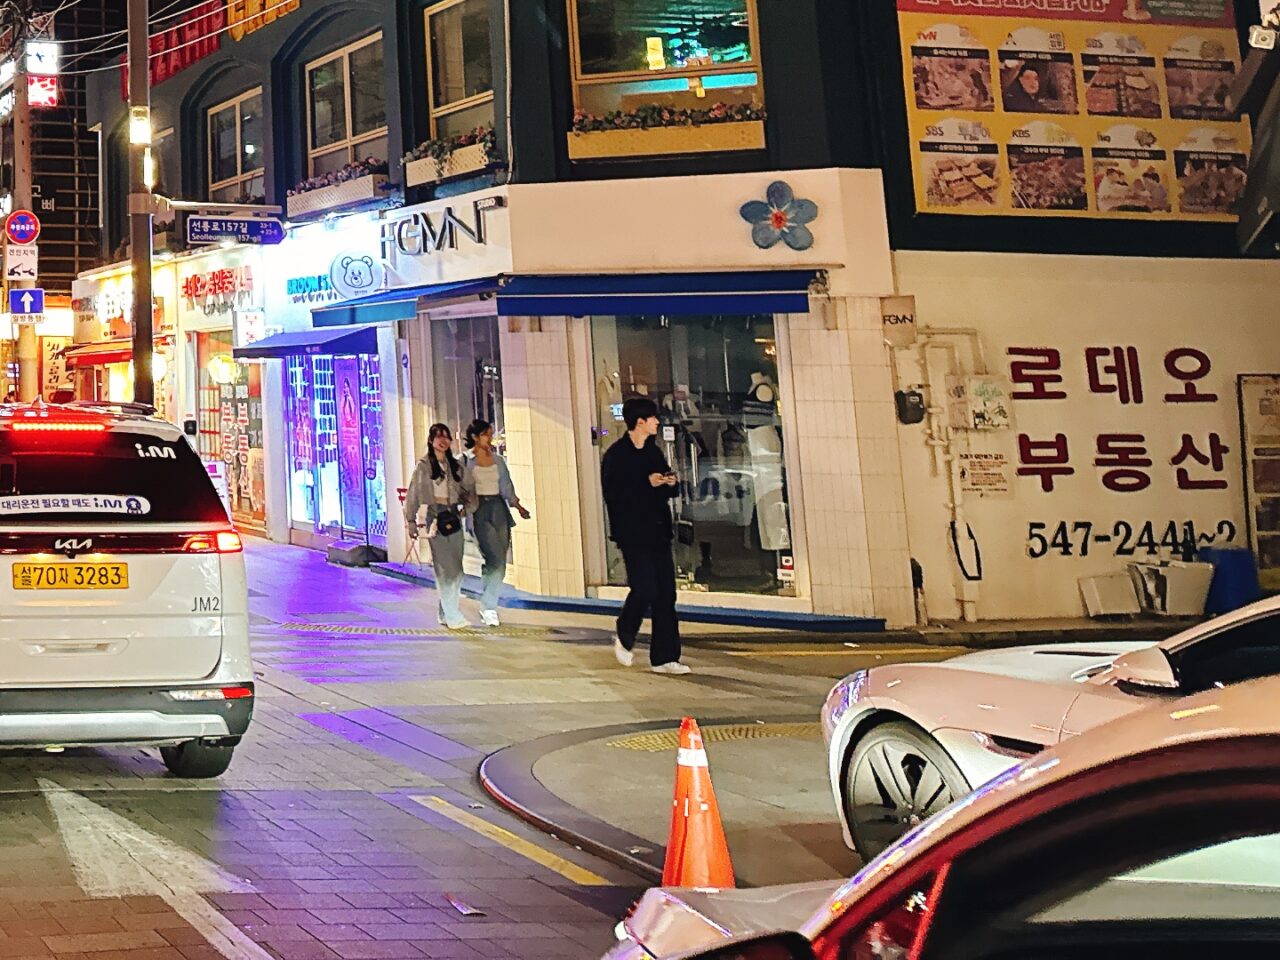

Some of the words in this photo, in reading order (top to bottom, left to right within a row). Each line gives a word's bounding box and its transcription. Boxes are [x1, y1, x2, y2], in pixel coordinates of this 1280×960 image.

[882, 313, 914, 325] FGMN
[1007, 345, 1219, 404] 로데오
[1016, 431, 1230, 493] 부동산
[1, 498, 40, 510] 대리운전
[41, 498, 70, 509] 필요할
[72, 498, 91, 508] 때도
[54, 538, 93, 550] KIA
[33, 566, 69, 586] 70자
[73, 566, 121, 586] 3283
[191, 597, 220, 613] JM2
